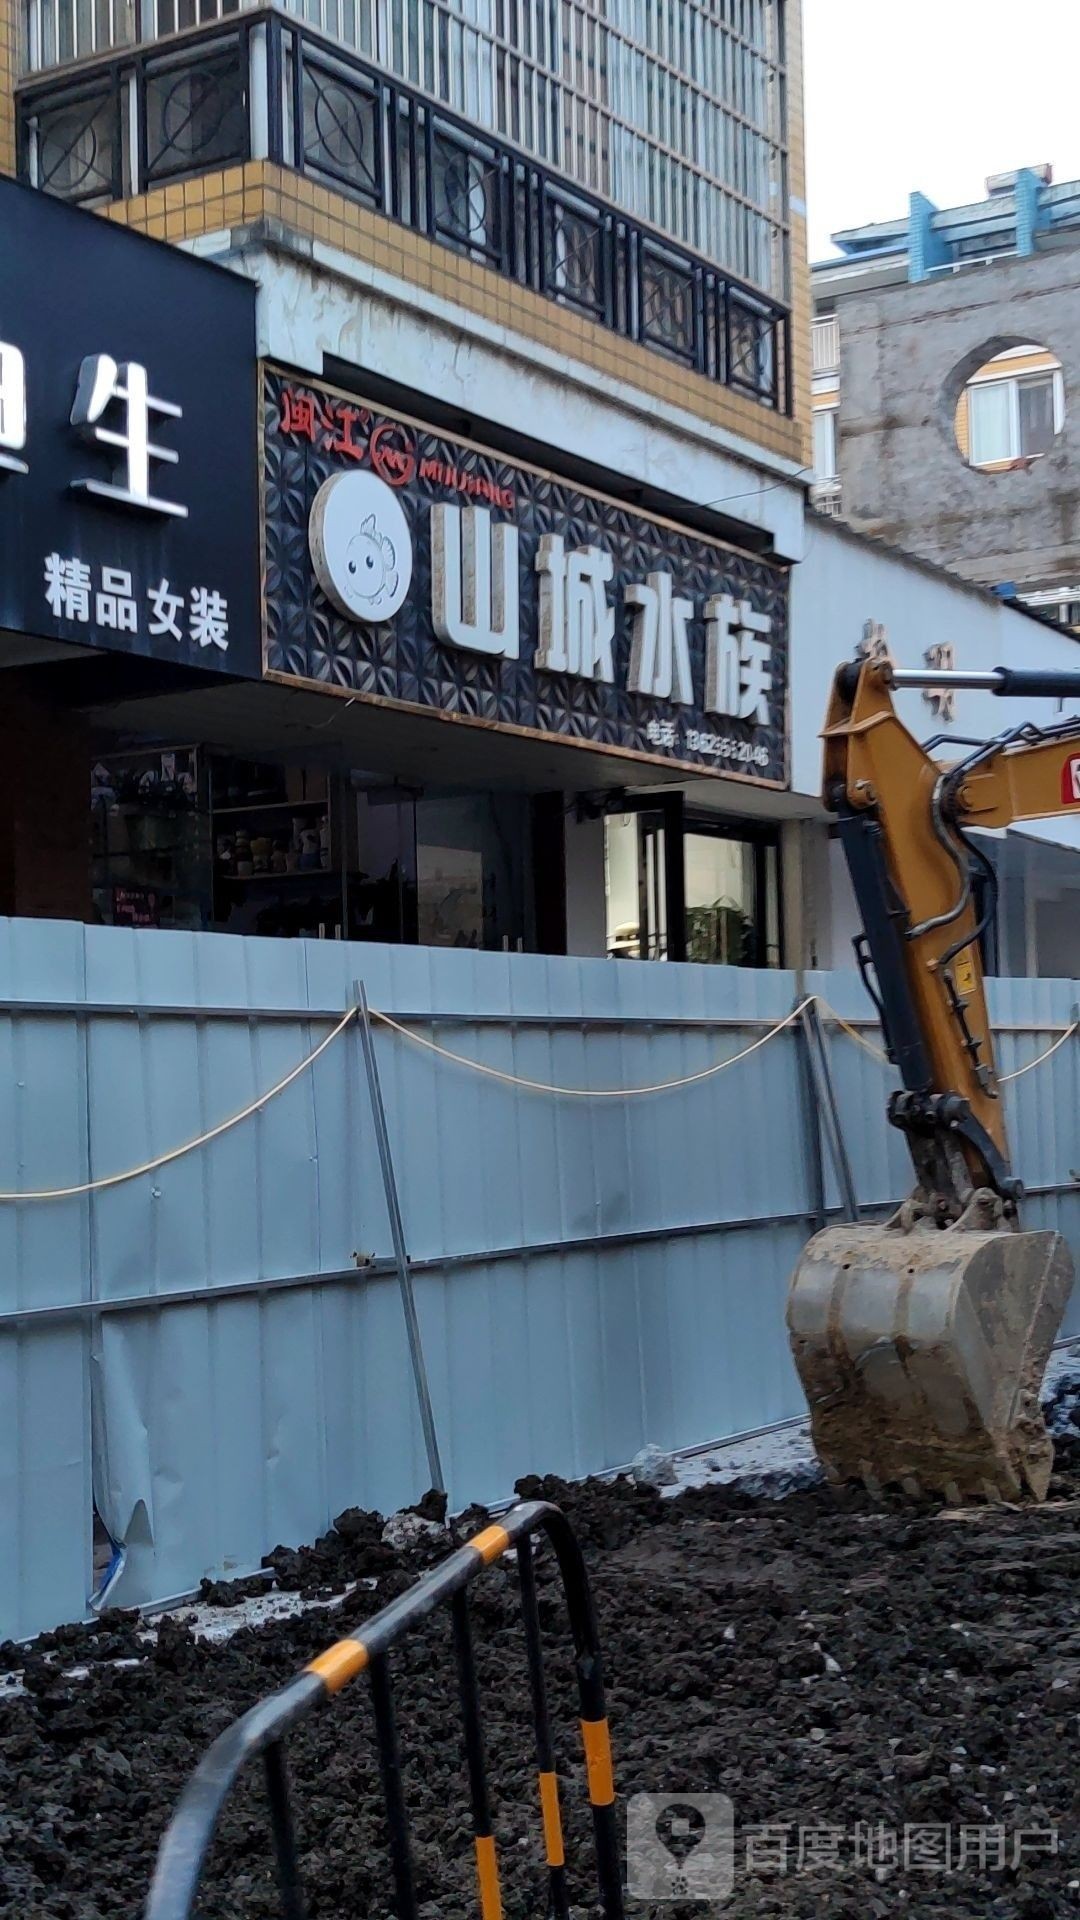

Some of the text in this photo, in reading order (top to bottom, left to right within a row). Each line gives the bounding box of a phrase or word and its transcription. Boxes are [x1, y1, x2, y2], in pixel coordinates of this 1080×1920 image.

[0, 340, 190, 518] 生
[280, 386, 364, 461] 闽江
[44, 551, 230, 651] 精品女装
[430, 501, 773, 726] 山城水族
